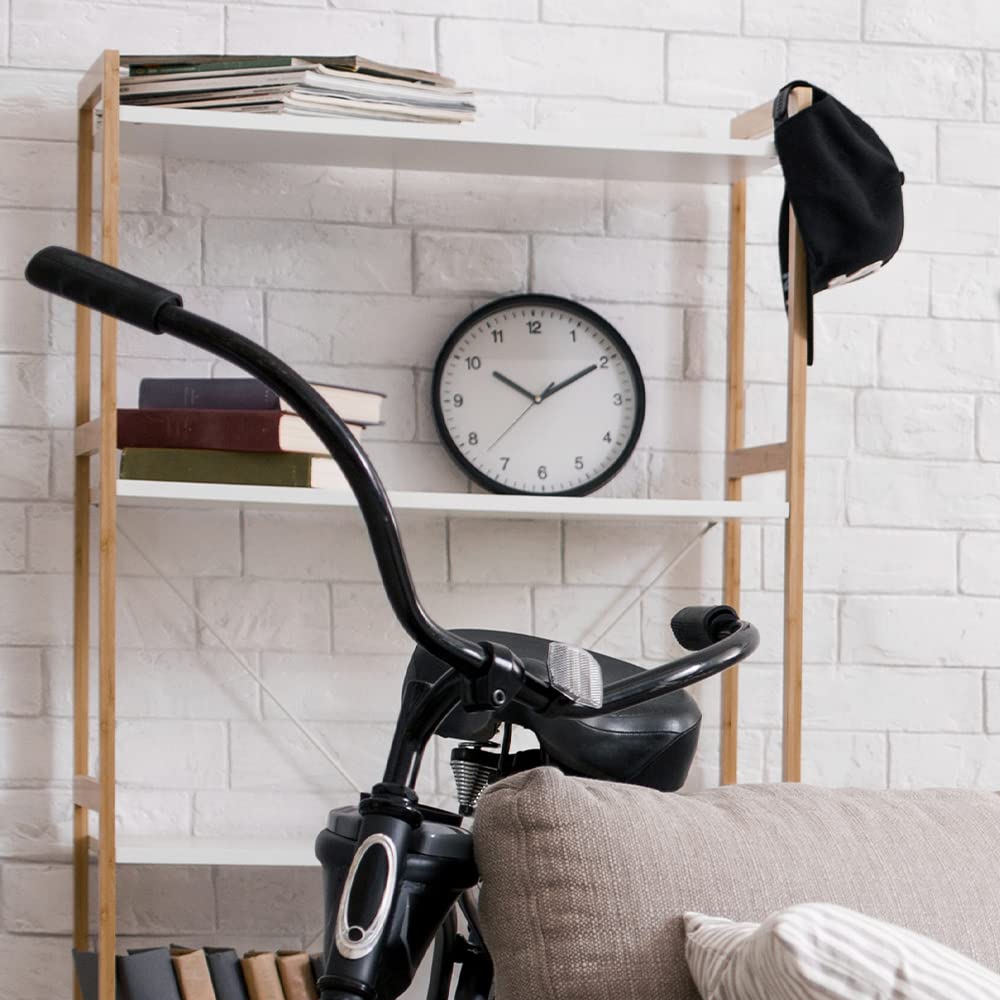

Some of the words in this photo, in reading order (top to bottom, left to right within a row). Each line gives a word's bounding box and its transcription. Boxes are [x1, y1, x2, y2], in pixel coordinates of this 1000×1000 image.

[526, 321, 541, 335] 12
[491, 330, 503, 343] 11
[569, 331, 576, 342] 1
[465, 356, 481, 370] 10
[599, 356, 609, 369] 2
[453, 394, 463, 407] 9
[613, 394, 622, 406] 3
[468, 432, 478, 445] 8
[602, 432, 612, 443] 4
[499, 457, 510, 470] 7
[574, 456, 584, 469] 5
[537, 466, 547, 479] 6
